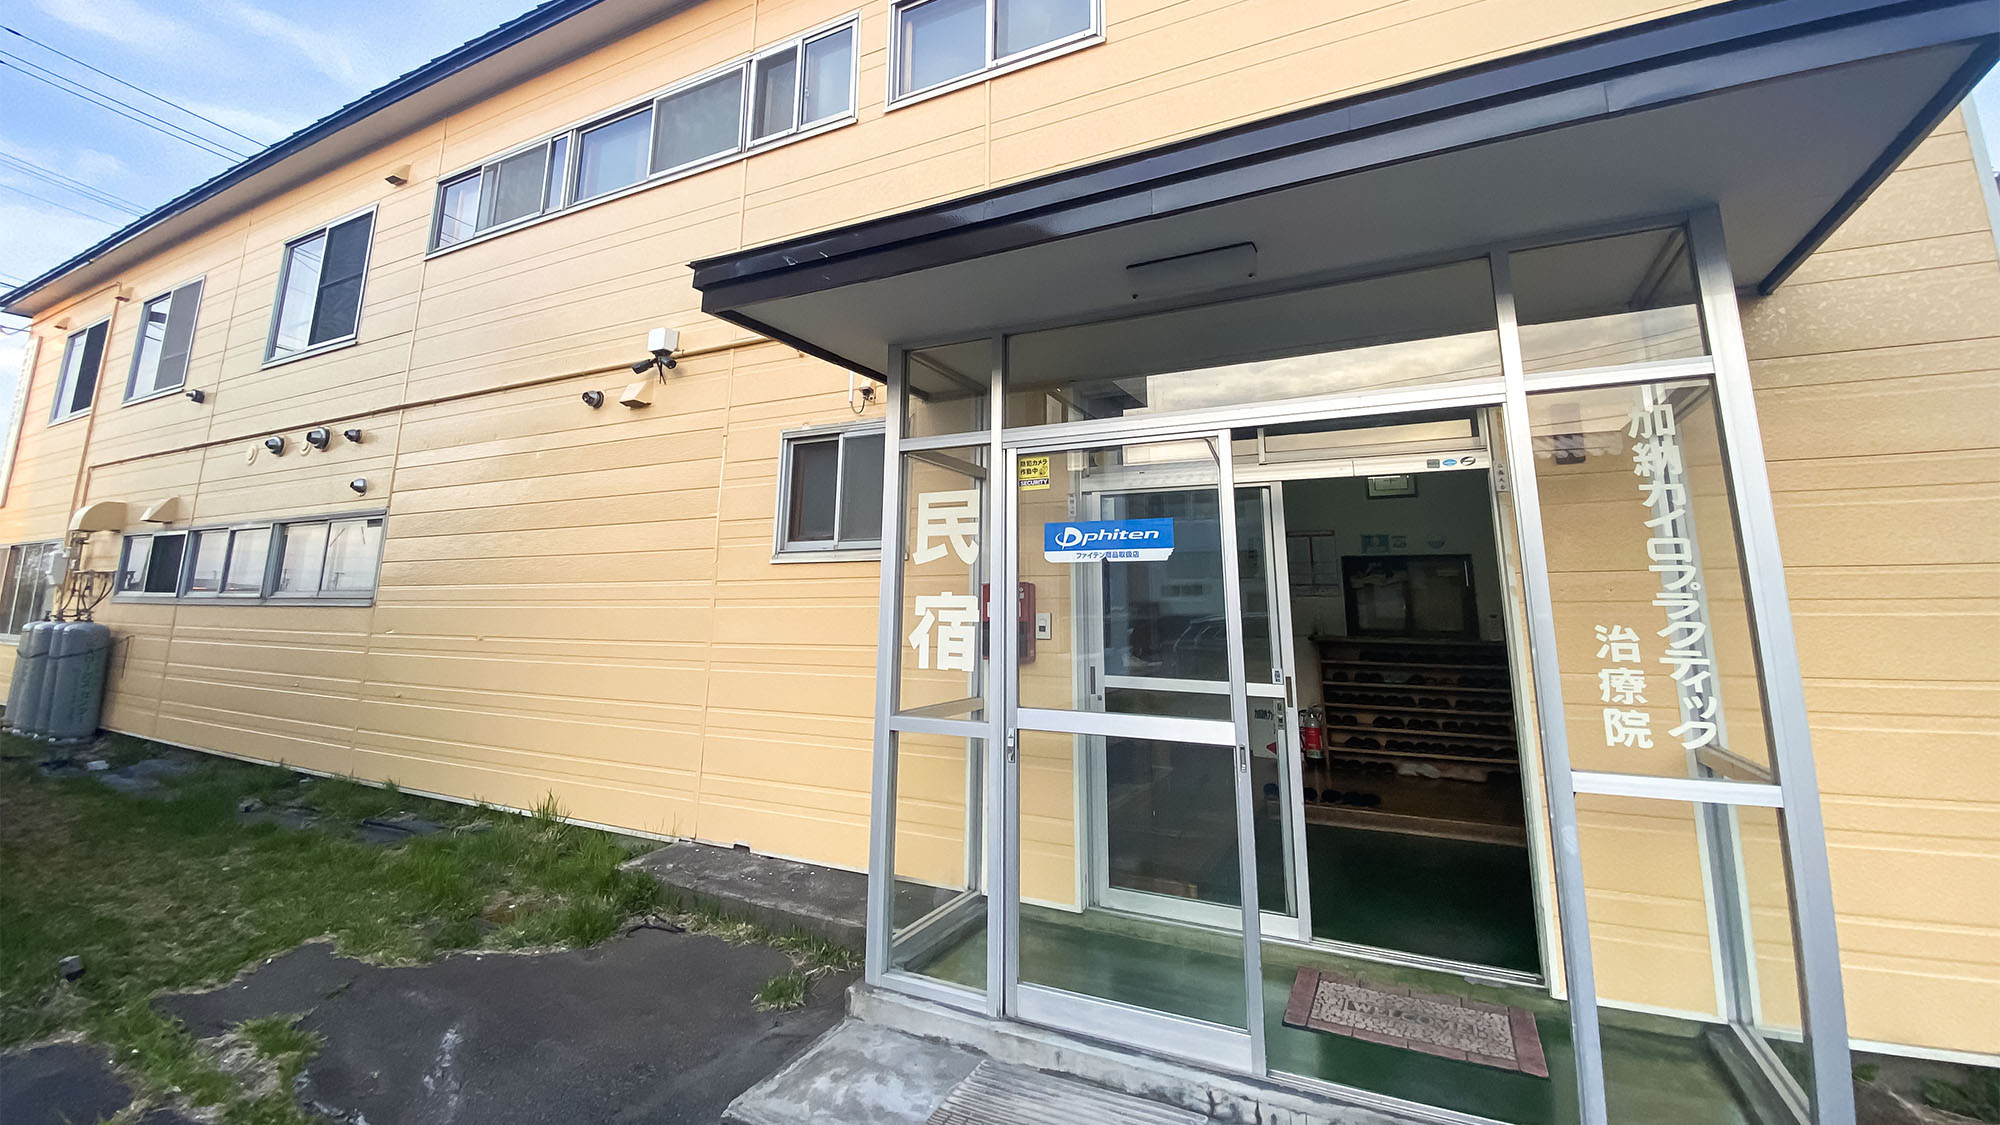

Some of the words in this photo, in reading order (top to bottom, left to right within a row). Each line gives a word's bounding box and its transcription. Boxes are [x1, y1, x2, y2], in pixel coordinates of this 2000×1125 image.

[909, 489, 979, 672] 民宿
[1076, 551, 1139, 559] ファイテン商品取扱店
[1628, 404, 1717, 749] 加納カイロプラクティック
[1594, 624, 1654, 749] 治療院
